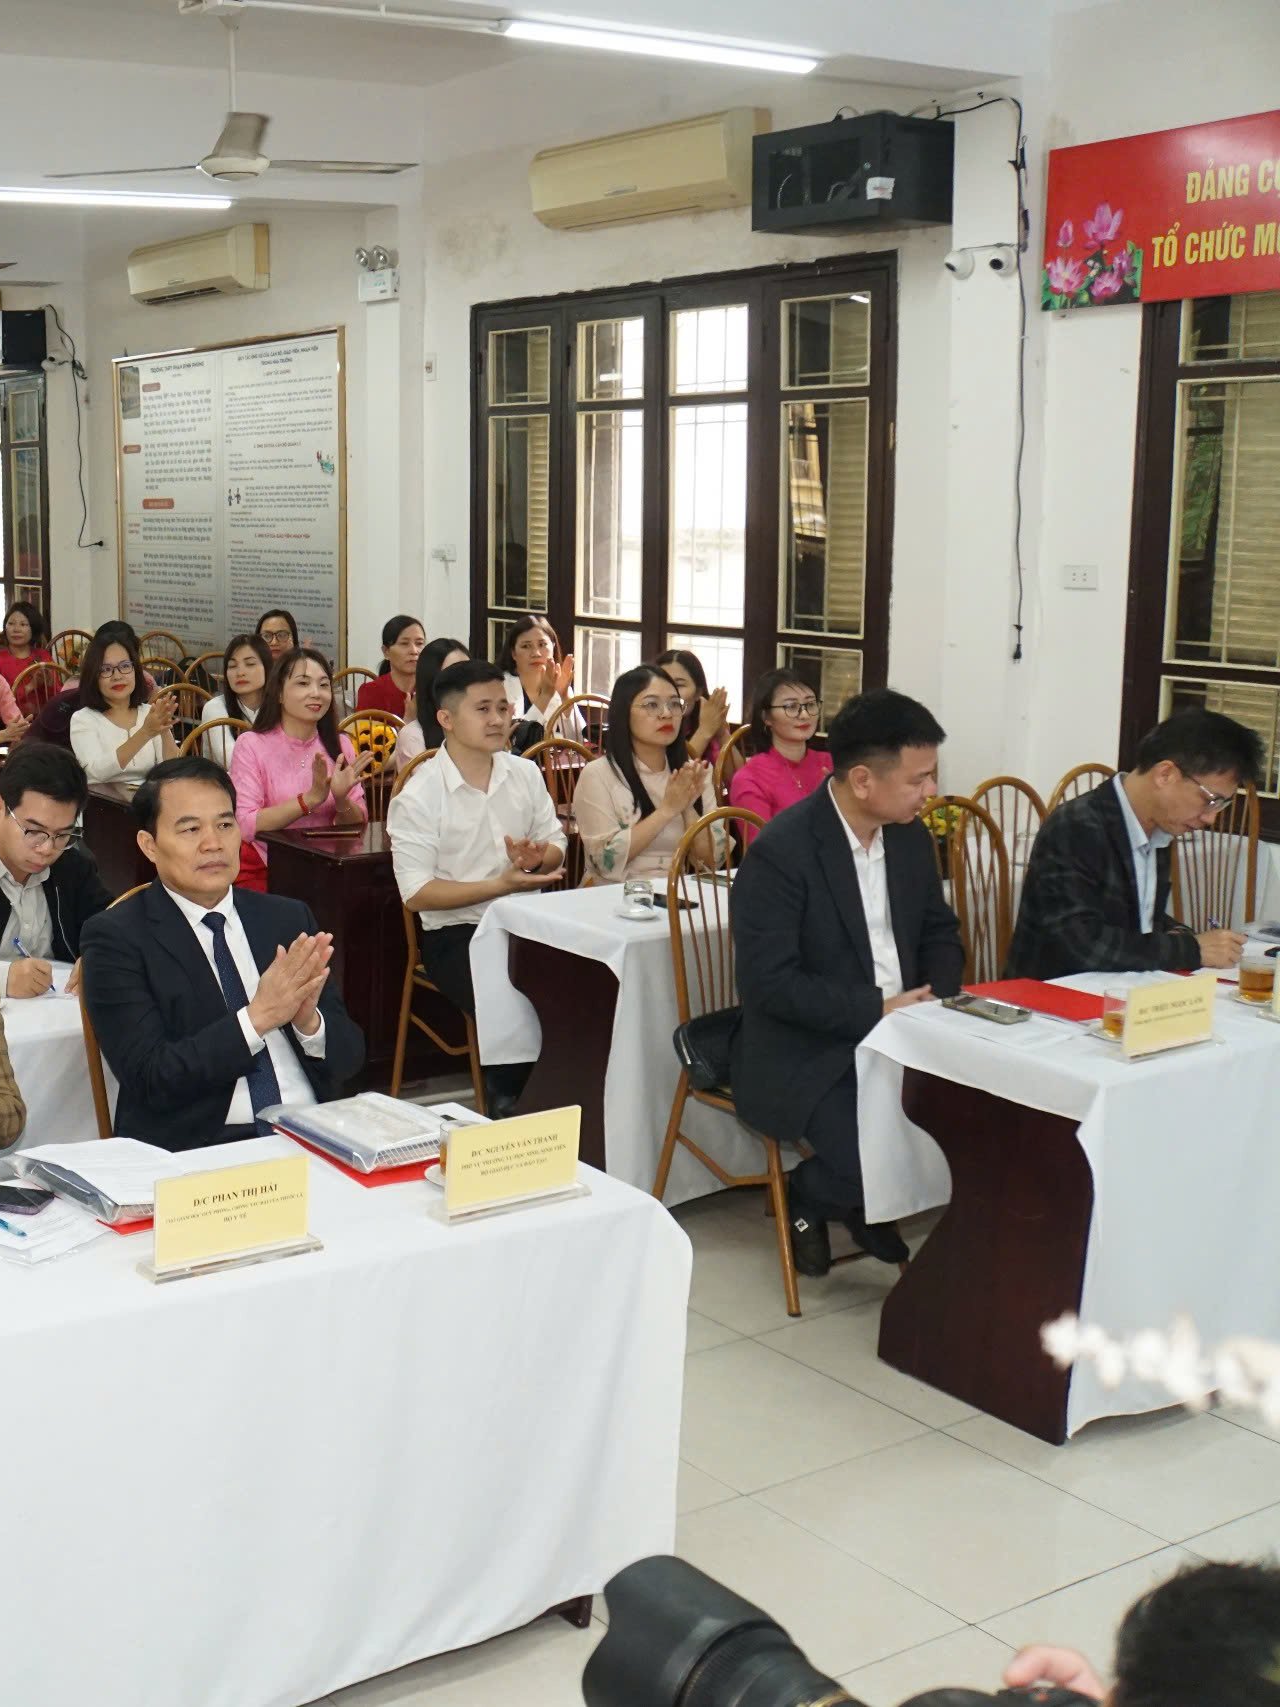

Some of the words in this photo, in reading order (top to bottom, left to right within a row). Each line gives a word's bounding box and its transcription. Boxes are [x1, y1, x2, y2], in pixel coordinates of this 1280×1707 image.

[1186, 159, 1250, 204] ĐẢNG
[1152, 222, 1180, 268] TỔ
[1184, 221, 1246, 265] CHỨC
[1253, 222, 1280, 257] M
[212, 1191, 238, 1203] PHAN
[240, 1187, 258, 1198] THỊ
